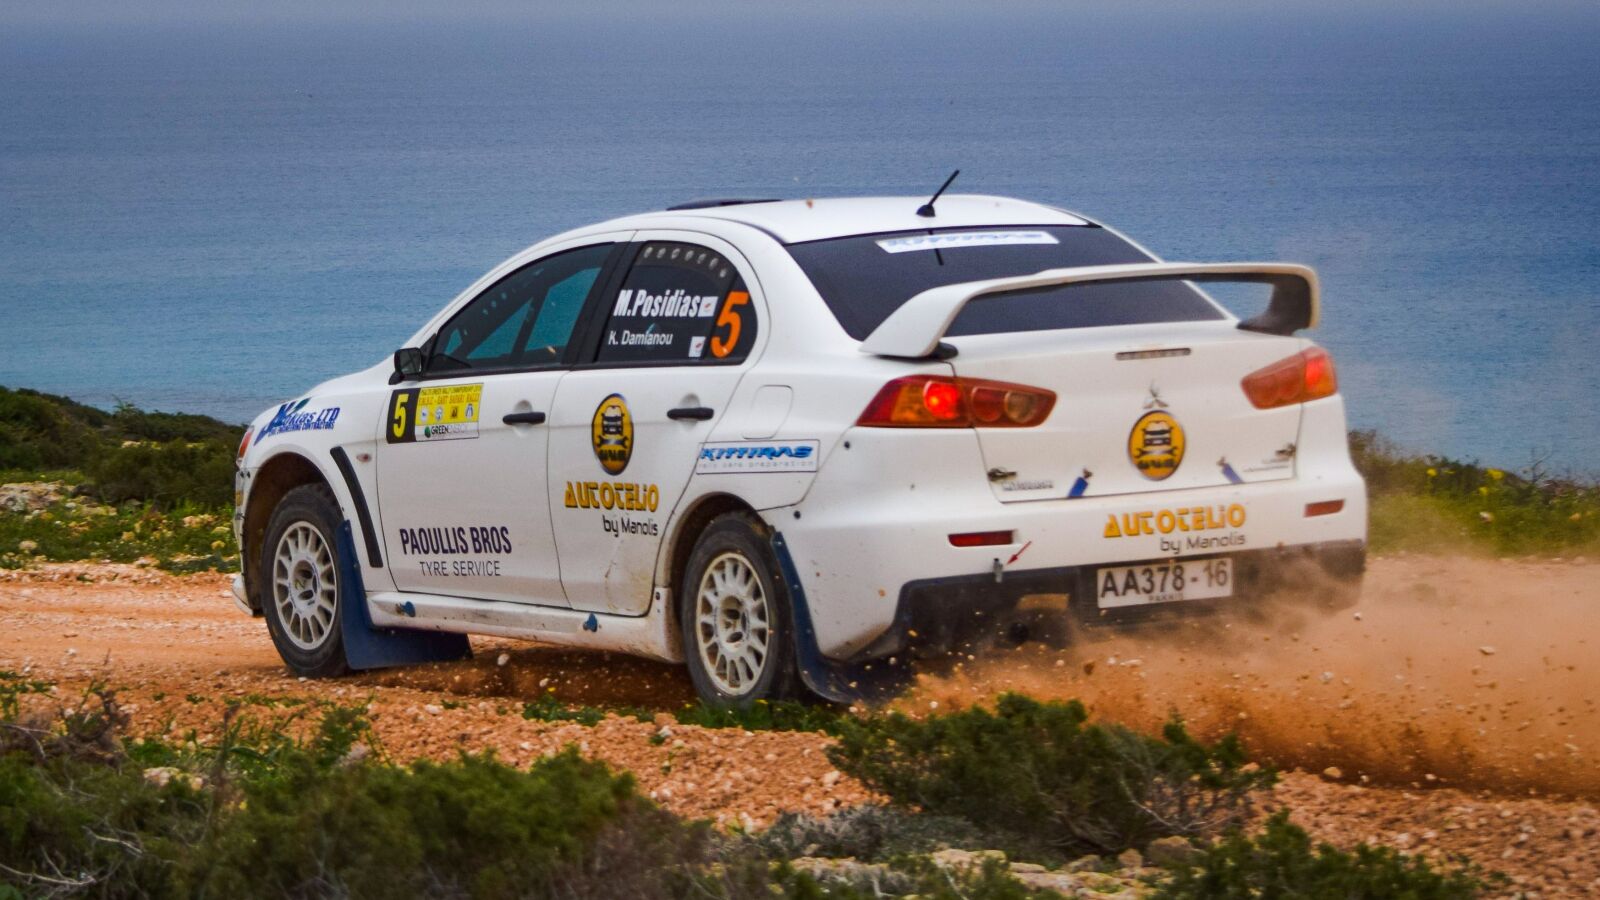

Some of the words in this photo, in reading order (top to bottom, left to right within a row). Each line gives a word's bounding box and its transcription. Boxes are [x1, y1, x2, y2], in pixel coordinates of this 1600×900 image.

[613, 289, 700, 317] M.Posidias
[710, 291, 750, 358] 5
[608, 330, 619, 345] K.
[621, 329, 674, 346] Damianou
[317, 407, 341, 422] LTD
[393, 393, 409, 438] 5
[602, 514, 619, 537] by
[621, 517, 659, 536] Manolis
[399, 526, 468, 555] PAOULLIS
[469, 526, 512, 554] BROS
[1160, 537, 1183, 555] by
[1186, 531, 1246, 549] Manolis
[420, 560, 449, 577] TYRE
[453, 560, 502, 576] SERVICE
